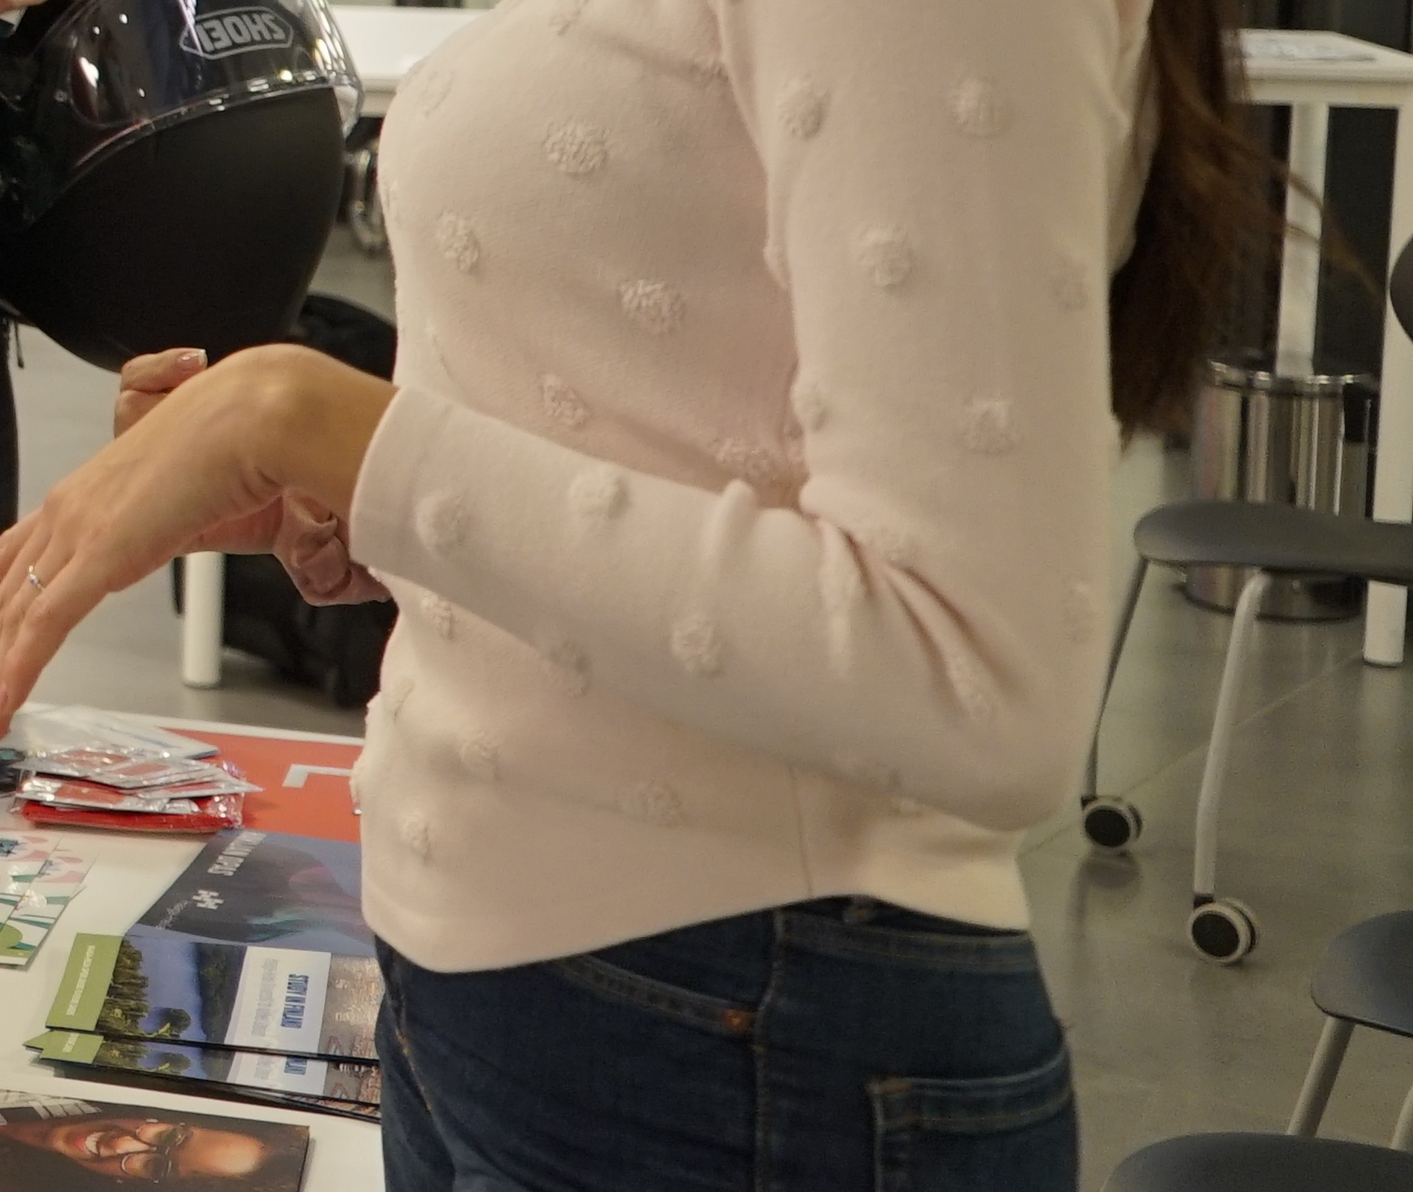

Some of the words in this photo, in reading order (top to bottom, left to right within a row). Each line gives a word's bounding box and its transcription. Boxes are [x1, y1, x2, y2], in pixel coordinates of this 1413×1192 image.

[198, 12, 284, 52] SHOEI
[286, 974, 309, 995] STUDY
[281, 1004, 305, 1029] FINLAND
